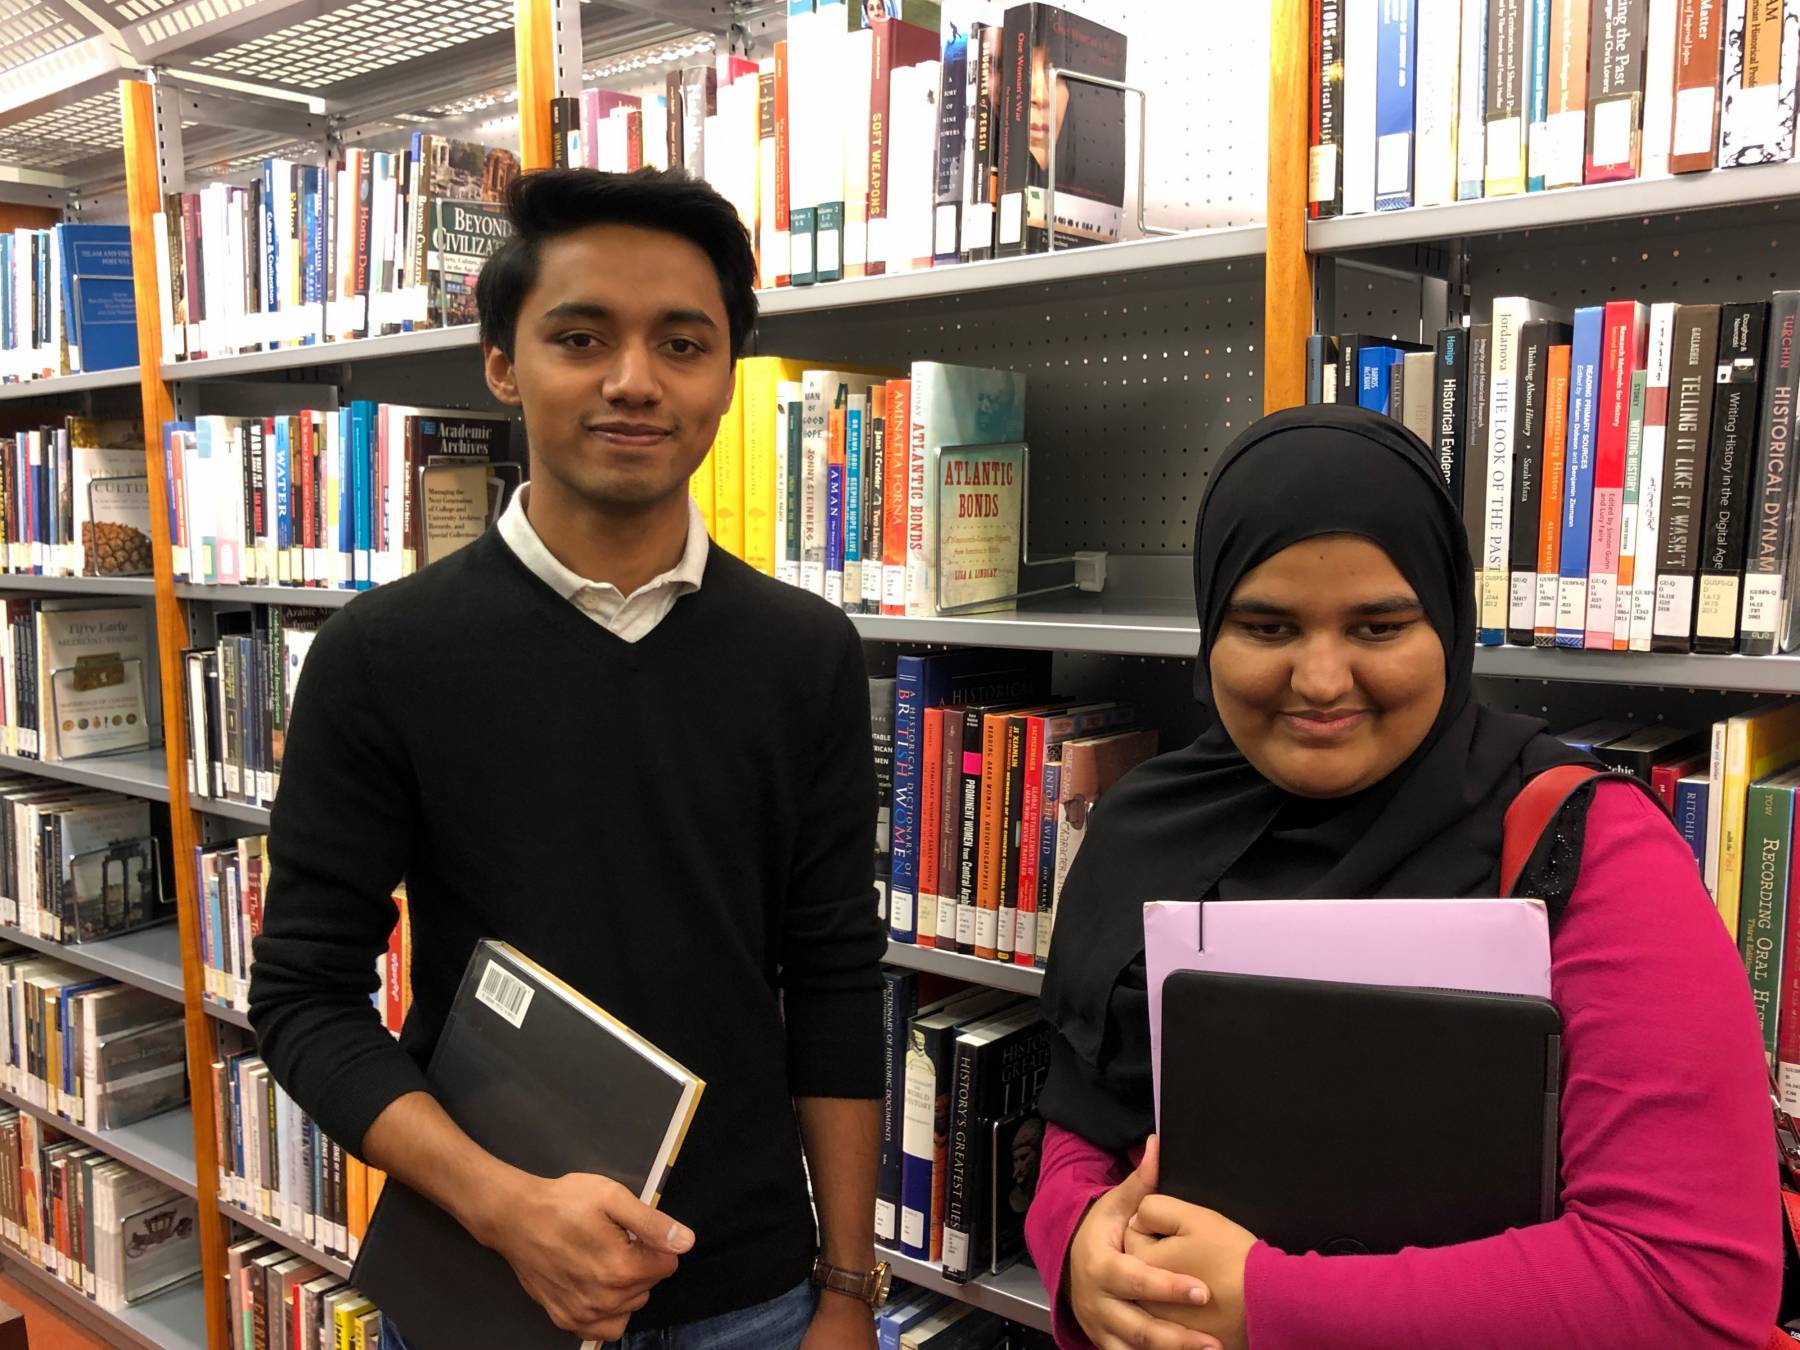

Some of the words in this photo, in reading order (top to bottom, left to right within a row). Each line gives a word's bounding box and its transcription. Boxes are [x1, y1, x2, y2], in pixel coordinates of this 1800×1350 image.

[1698, 0, 1713, 40] Matter
[1322, 40, 1332, 51] of
[1604, 40, 1614, 64] Chris
[1616, 28, 1630, 51] the
[1748, 23, 1761, 64] Historical
[981, 42, 991, 96] DAUGHTER
[1507, 54, 1515, 69] and
[1614, 54, 1630, 86] Past
[1016, 56, 1024, 99] Woman's
[1506, 70, 1515, 99] Shared
[1603, 64, 1612, 94] Lorenz
[980, 98, 989, 108] of
[1015, 102, 1023, 122] War
[872, 112, 882, 147] SOFT
[979, 112, 988, 152] PERSIA
[554, 132, 562, 161] WOMAN
[870, 150, 882, 216] WEAPONS
[266, 212, 274, 243] Culture
[360, 206, 369, 252] Homo
[416, 194, 427, 233] BEYOND
[454, 207, 512, 238] BEYOND
[266, 244, 275, 254] &
[358, 255, 368, 290] Deus
[1445, 335, 1456, 365] Henige
[1478, 338, 1488, 360] Integrity
[1498, 313, 1512, 371] Jordanova
[1617, 326, 1627, 356] Research
[1689, 328, 1701, 366] GALLAGHER
[1780, 314, 1795, 368] TURCHIN
[1478, 360, 1486, 373] and
[1525, 344, 1536, 381] Thinking
[1575, 365, 1584, 386] Edited
[1615, 358, 1624, 389] Methods
[804, 392, 821, 401] MAN
[1478, 374, 1486, 401] Historical
[1495, 379, 1508, 414] THE
[1526, 382, 1534, 407] About
[1584, 365, 1593, 398] READING
[1614, 390, 1622, 400] for
[1632, 383, 1641, 407] STOREY
[1441, 378, 1456, 434] Historical
[1551, 377, 1565, 458] Deconstructing
[1574, 398, 1583, 422] Miriam
[1582, 399, 1592, 433] PRIMARY
[1612, 402, 1622, 427] History
[1678, 375, 1702, 432] TELLING
[1724, 392, 1741, 432] Writing
[437, 421, 493, 440] Academic
[892, 390, 905, 468] AMINATTA
[1523, 408, 1533, 437] History
[1573, 423, 1581, 450] Dobson
[1628, 419, 1640, 456] WRITING
[250, 424, 263, 455] WAR!
[439, 439, 490, 455] Archives
[874, 430, 883, 450] Jane
[1493, 420, 1506, 465] LOOK
[1581, 434, 1590, 469] SOURCES
[1676, 438, 1696, 450] IT
[1721, 434, 1737, 473] History
[1765, 386, 1791, 496] HISTORICAL
[806, 448, 816, 482] JONNY
[910, 422, 925, 500] ATLANTIC
[944, 460, 1014, 487] ATLANTIC
[1522, 458, 1531, 480] Sarah
[1626, 458, 1638, 493] HISTORY
[1672, 458, 1695, 489] LIKE
[276, 449, 287, 518] WATER
[428, 488, 457, 497] Managing
[830, 470, 839, 517] AMAN
[1492, 470, 1505, 491] OF
[1549, 462, 1561, 501] History
[1570, 466, 1579, 497] Benjamin
[1722, 474, 1732, 485] in
[892, 474, 904, 525] FORNA
[958, 493, 1000, 519] BONDS
[1598, 493, 1606, 506] and
[1606, 493, 1616, 513] Edited
[1671, 495, 1691, 509] IT
[1720, 487, 1732, 506] the
[428, 514, 457, 523] University
[806, 484, 816, 542] STEINBERG
[872, 510, 881, 526] Two
[910, 505, 923, 551] BONDS
[1490, 496, 1504, 531] THE
[1596, 508, 1605, 525] Lucy
[1604, 515, 1614, 526] by
[1716, 510, 1731, 546] Digital
[1604, 528, 1614, 549] Simon
[1759, 502, 1782, 574] DYNAM
[1489, 536, 1502, 574] PAST
[1604, 550, 1612, 570] Gunn
[1714, 548, 1727, 569] Age
[896, 689, 910, 778] BRITISH
[907, 706, 916, 777] HISTORICAL
[1012, 726, 1020, 735] JI
[1012, 735, 1020, 768] XIANLIN
[964, 778, 976, 819] PROMINENT
[1045, 770, 1054, 798] INTO
[904, 782, 914, 855] DICTIONARY
[1044, 802, 1053, 821] THE
[1684, 792, 1697, 841] RITCHIE
[1764, 794, 1774, 816] YOW
[894, 788, 908, 876] WOMEN
[963, 820, 974, 847] WOMEN
[1042, 824, 1052, 855] WILD
[904, 863, 912, 876] OF
[963, 848, 971, 860] from
[962, 861, 973, 887] Central
[1758, 838, 1780, 929] RECORDING
[250, 892, 259, 917] The
[1746, 918, 1756, 942] Third
[1754, 937, 1773, 981] ORAL
[886, 980, 894, 1033] DICTIONARY
[886, 1034, 894, 1045] OF
[957, 1056, 971, 1127] HISTORY'S
[884, 1088, 893, 1142] DOCUMENTS
[952, 1131, 966, 1199] GREATEST
[950, 1202, 962, 1229] LIES
